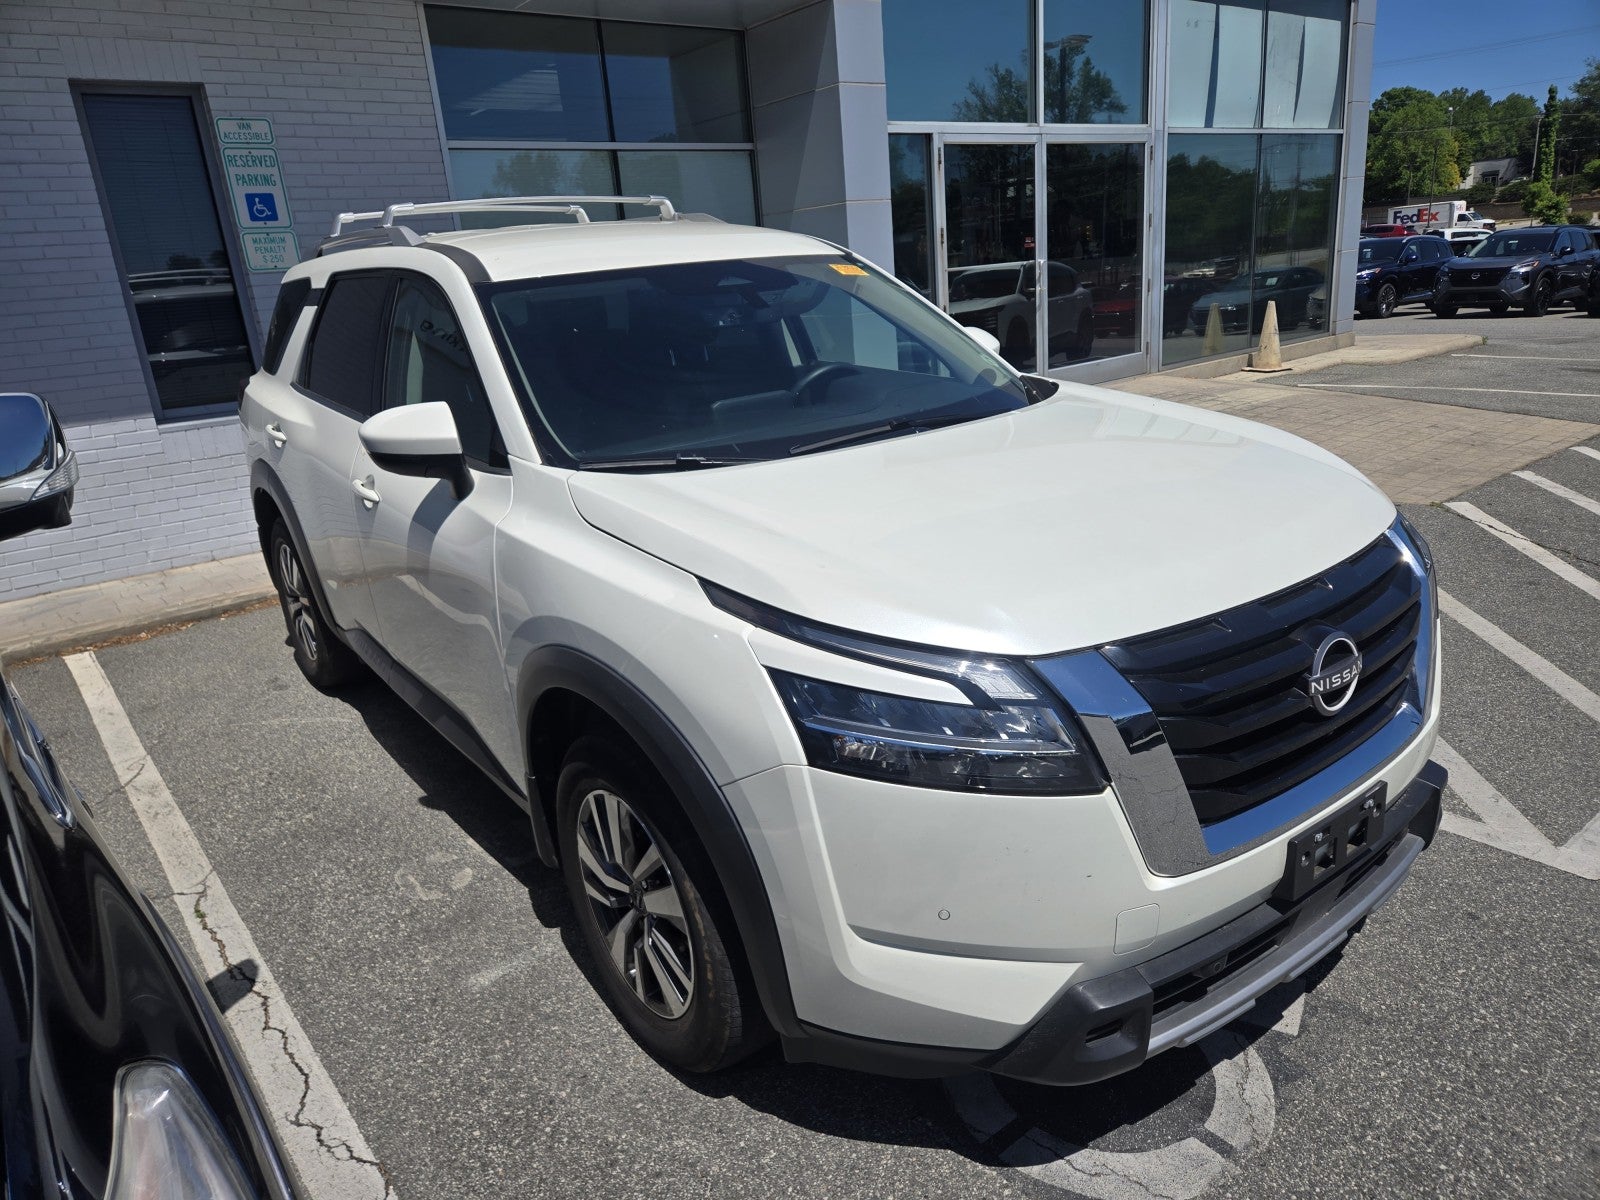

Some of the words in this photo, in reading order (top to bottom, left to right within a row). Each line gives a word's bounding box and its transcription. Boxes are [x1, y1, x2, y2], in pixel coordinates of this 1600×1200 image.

[237, 122, 252, 131] VAN
[224, 132, 270, 140] ACCESSIBLE
[226, 155, 276, 168] RESERVED
[234, 173, 277, 187] PARKING
[1393, 208, 1439, 224] FedEx
[251, 236, 287, 246] MAXIMUM
[254, 245, 287, 255] PENALTY
